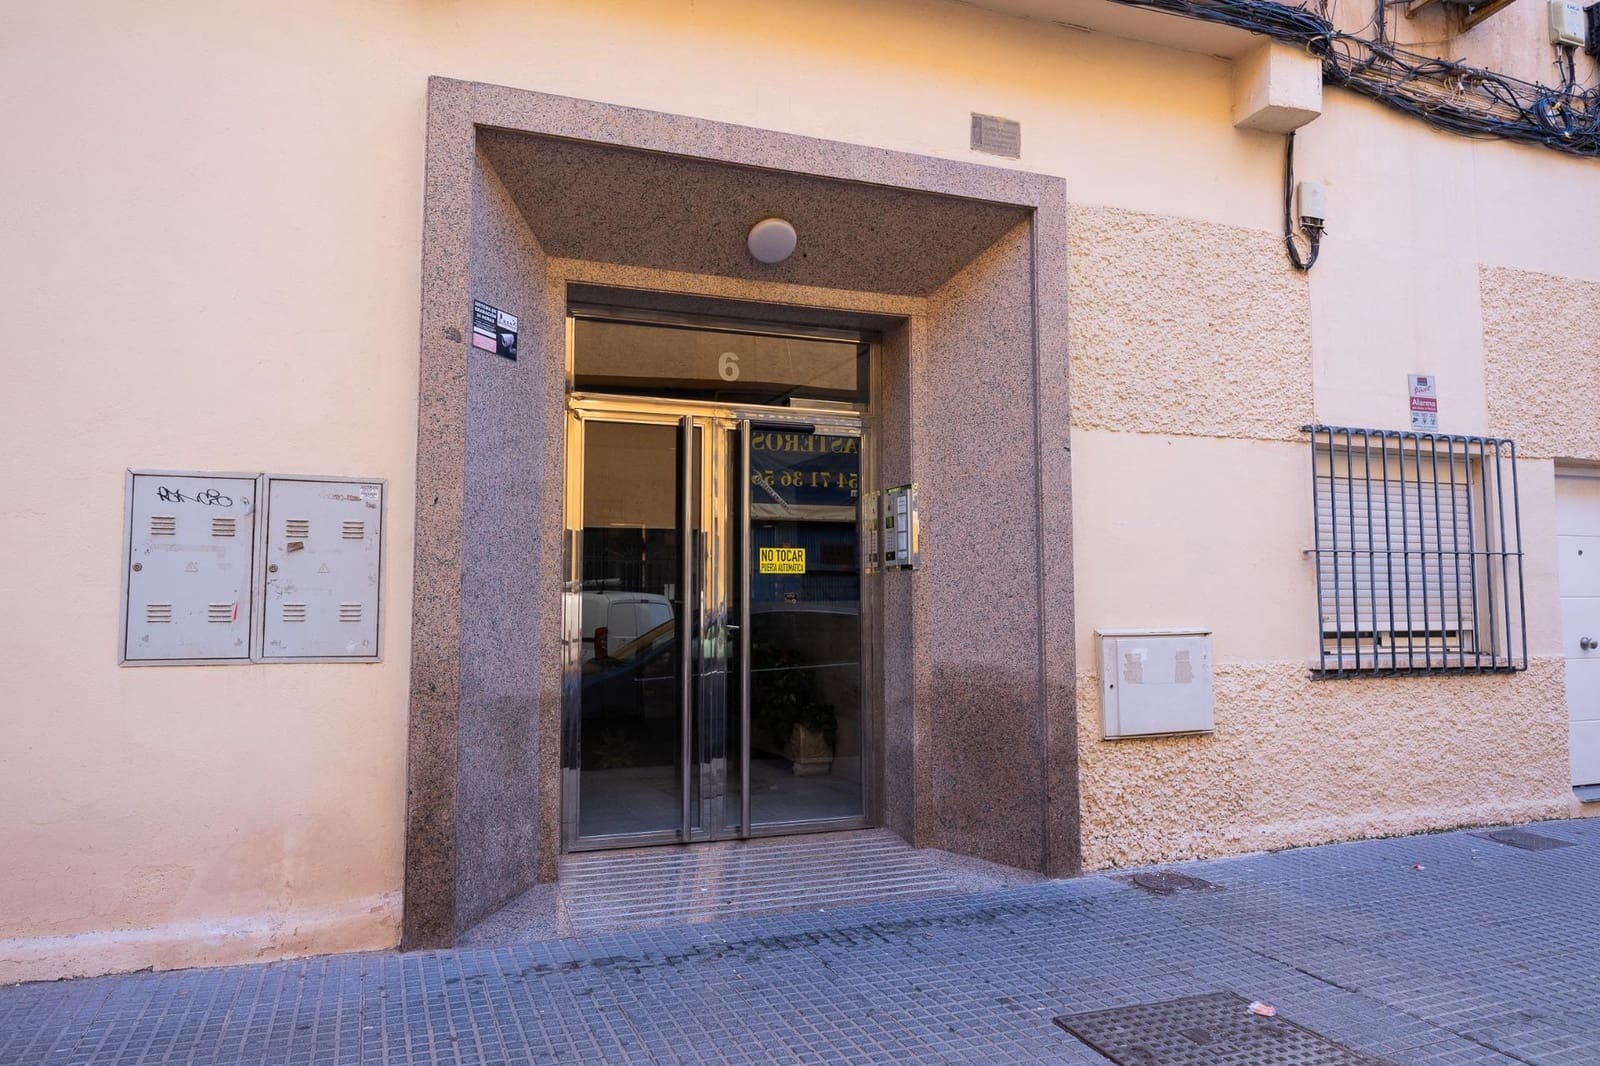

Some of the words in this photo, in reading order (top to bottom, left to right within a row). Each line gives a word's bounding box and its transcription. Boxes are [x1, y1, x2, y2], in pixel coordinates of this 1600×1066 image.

[719, 352, 740, 382] 6
[761, 549, 774, 562] NO
[776, 549, 804, 562] TOCAR
[761, 562, 777, 572] PUERTA
